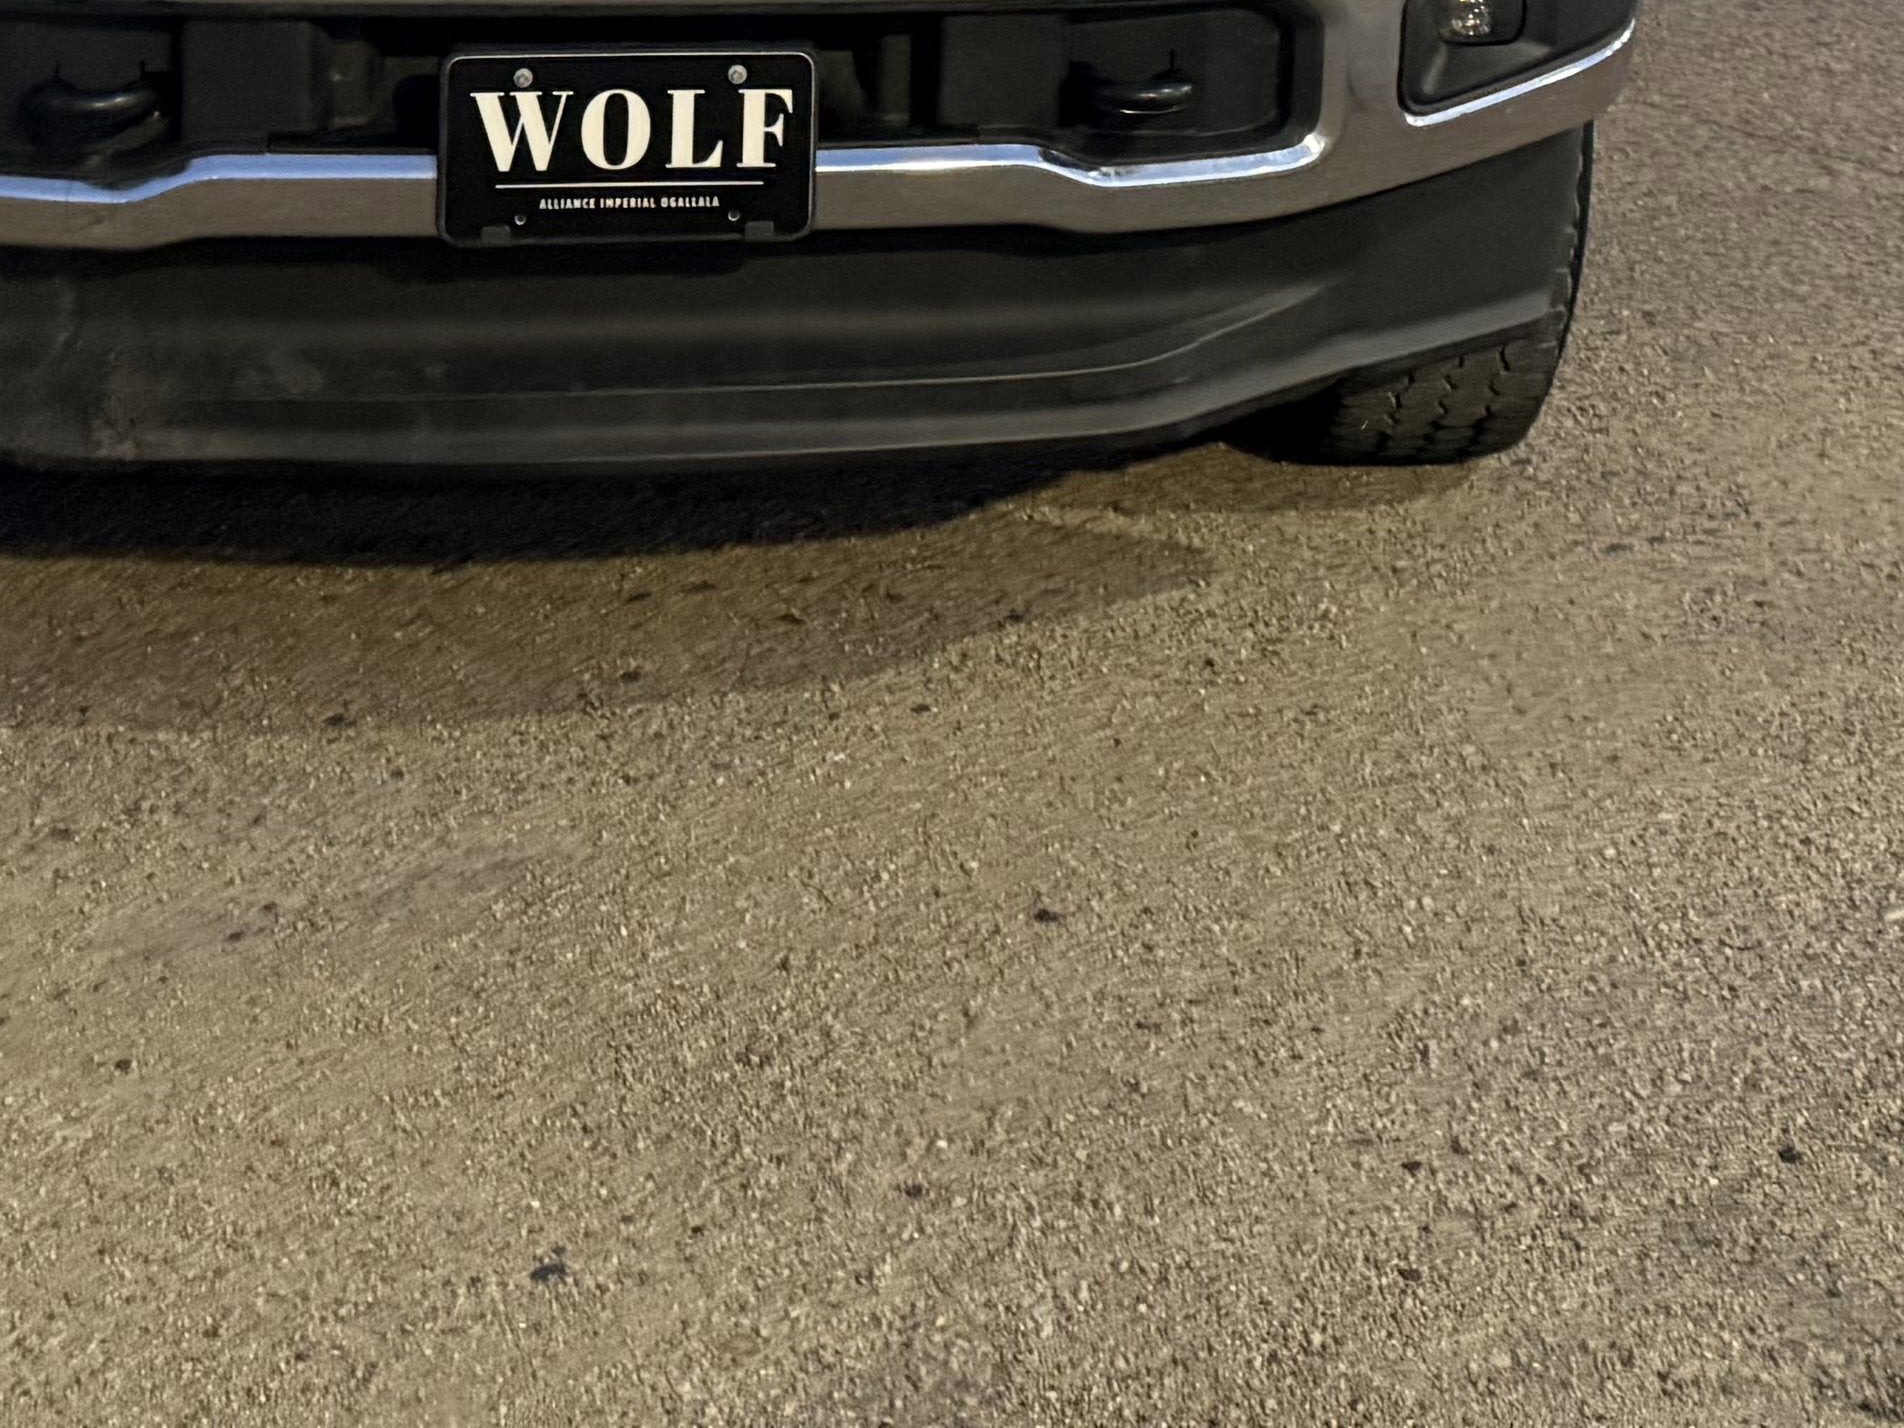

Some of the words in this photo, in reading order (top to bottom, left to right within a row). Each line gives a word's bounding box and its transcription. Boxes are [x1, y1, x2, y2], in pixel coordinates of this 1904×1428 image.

[469, 88, 794, 172] WOLF
[539, 198, 595, 209] ALLIANCE
[600, 198, 656, 208] IMPERIAL
[661, 196, 720, 207] OGALLALA
